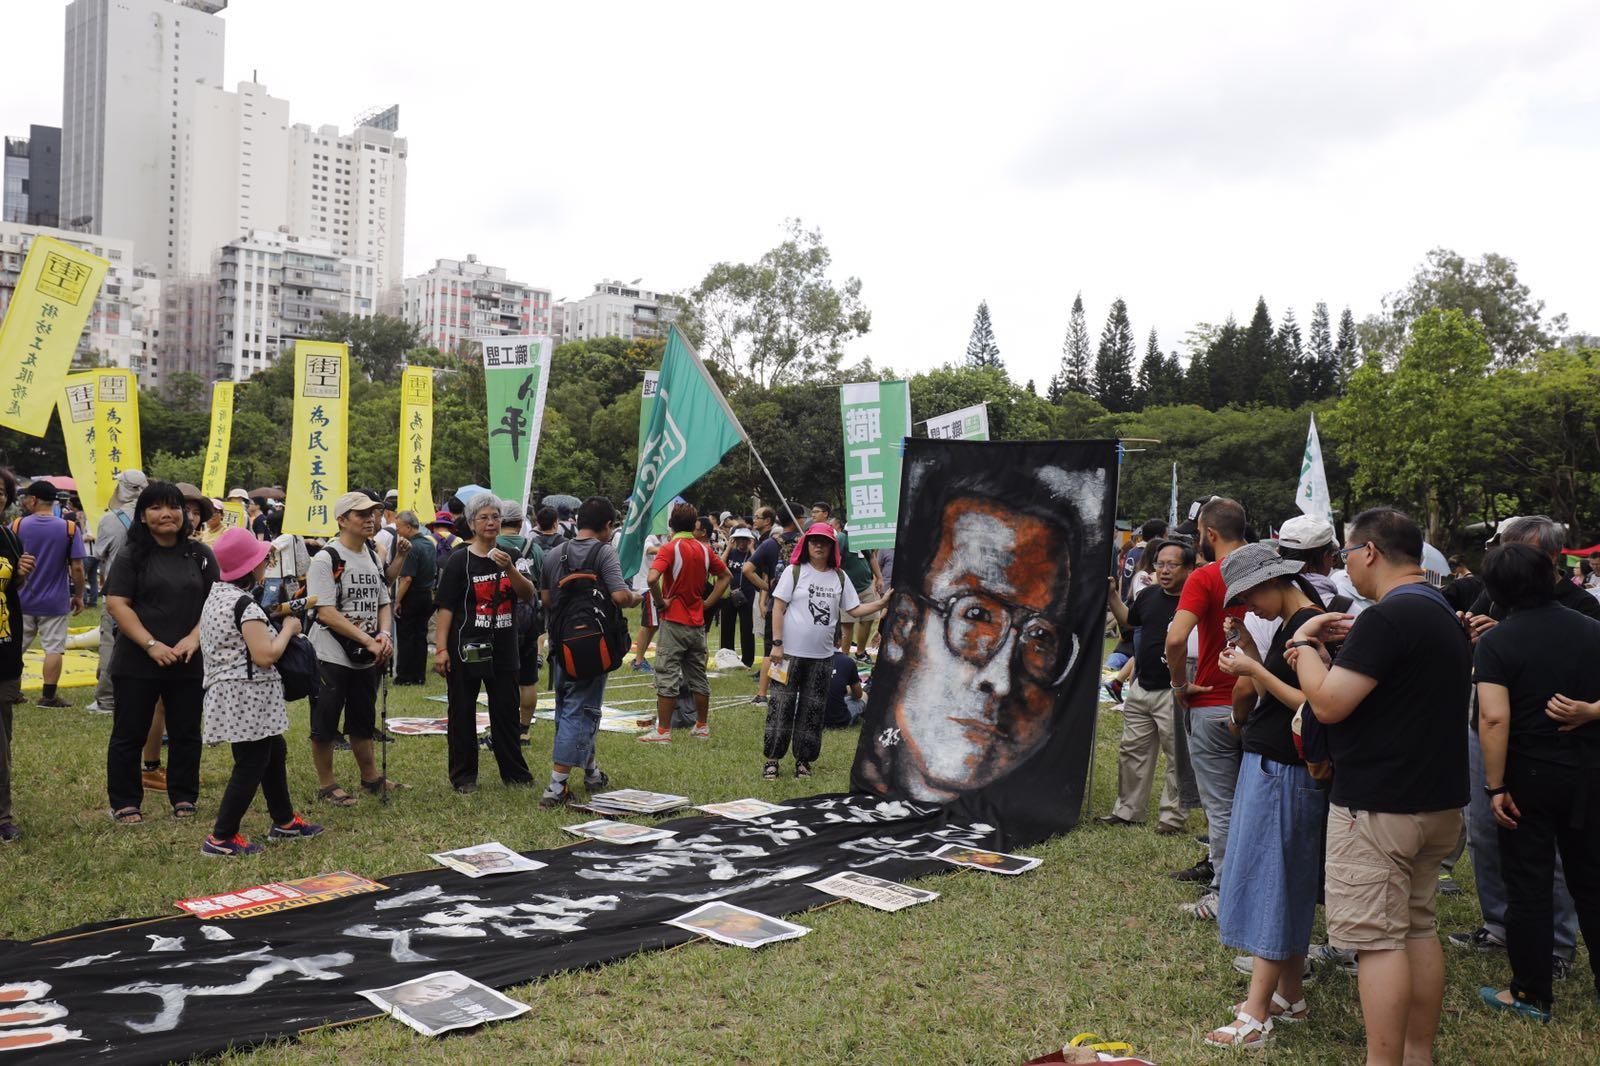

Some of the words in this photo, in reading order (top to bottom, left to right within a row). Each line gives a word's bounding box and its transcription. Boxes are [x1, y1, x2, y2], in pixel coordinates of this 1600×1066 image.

[379, 158, 388, 198] THE
[307, 404, 330, 525] 為民主奮鬥
[350, 573, 378, 585] LEGO
[347, 587, 380, 599] PARTY
[352, 601, 377, 612] TIME
[474, 620, 513, 629] MOERS
